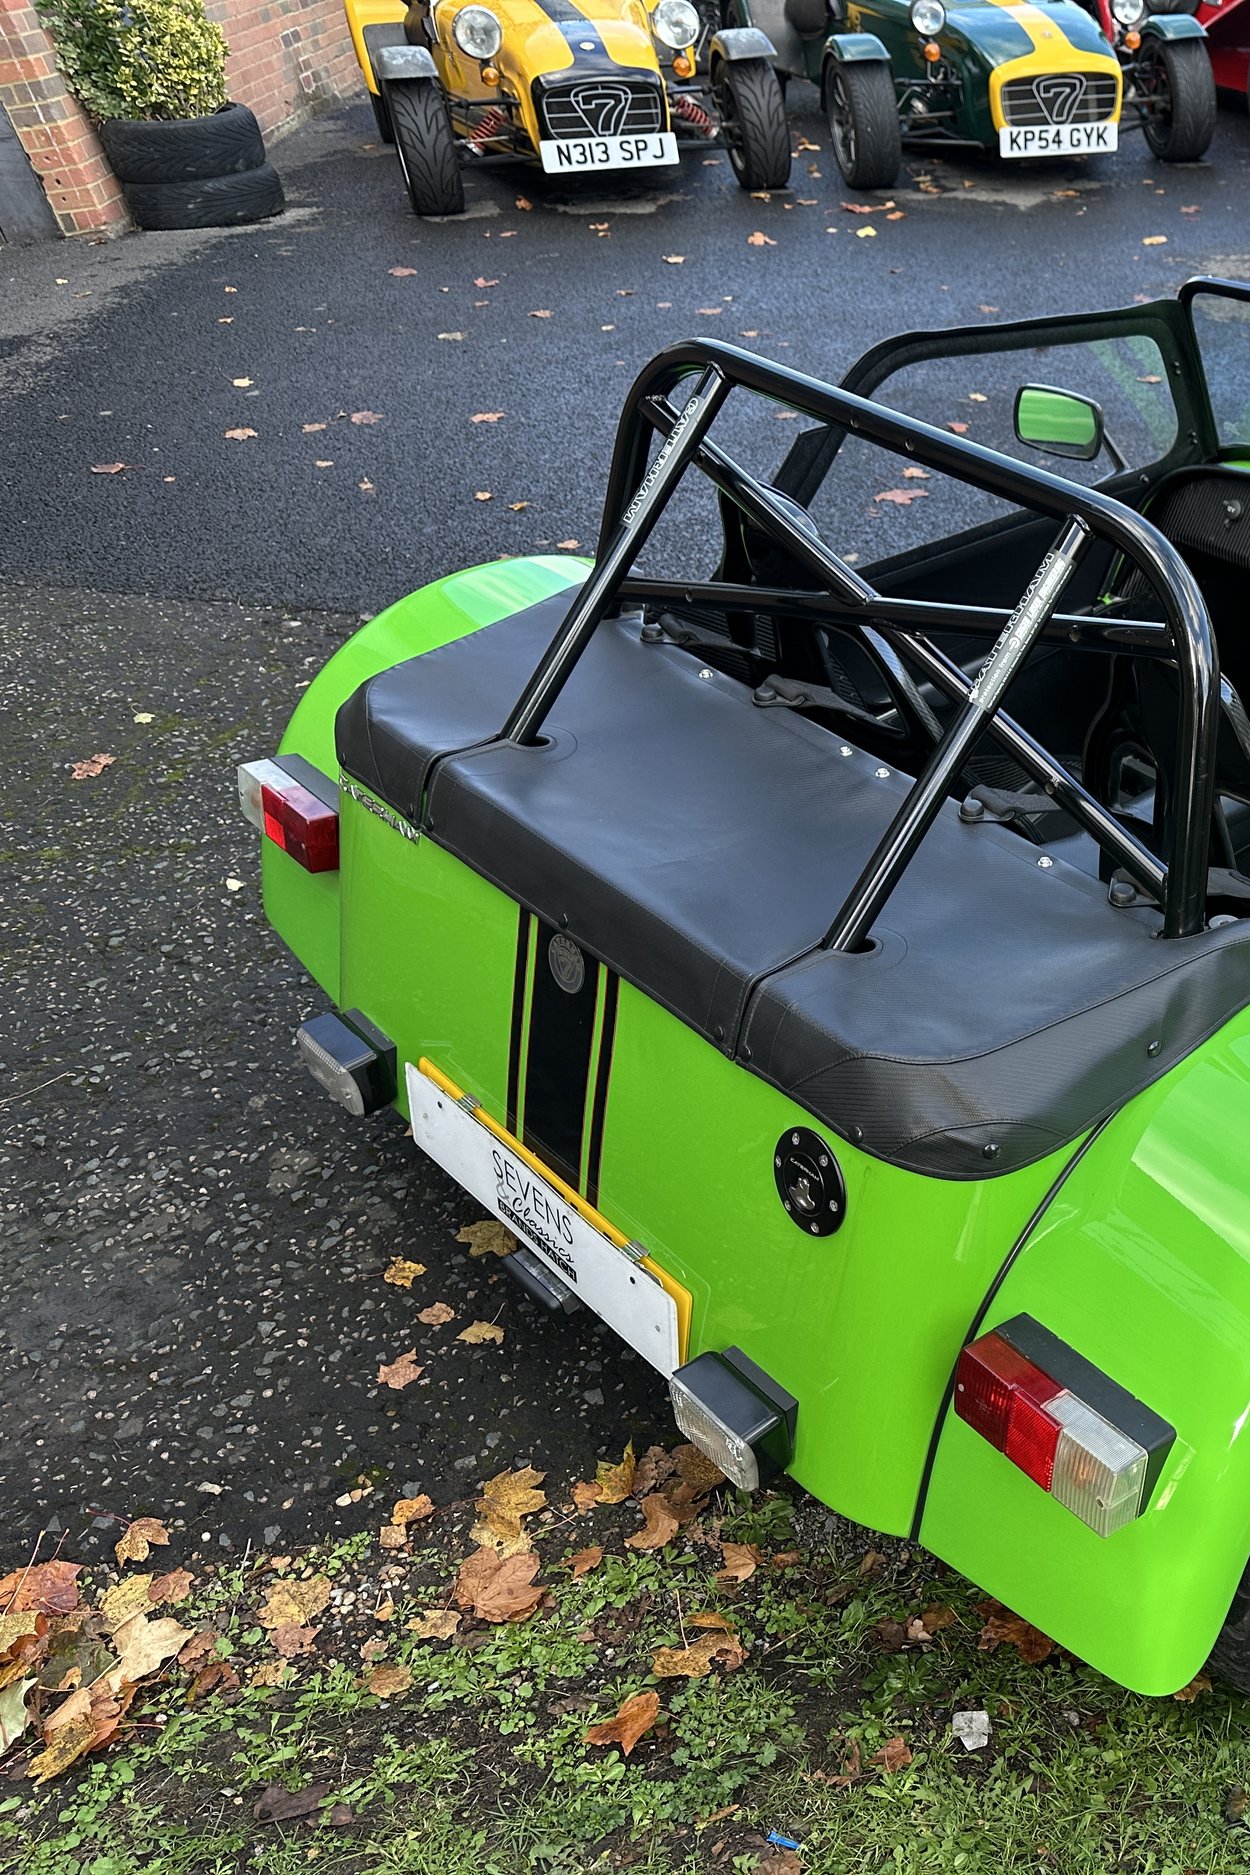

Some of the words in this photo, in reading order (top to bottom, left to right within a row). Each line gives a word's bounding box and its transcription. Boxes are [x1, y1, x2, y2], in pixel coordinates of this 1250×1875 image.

[556, 142, 610, 166] N313
[620, 138, 665, 161] SPJ
[1010, 129, 1062, 151] KP54
[1070, 126, 1107, 148] GYK
[623, 397, 699, 524] CATERHAM
[979, 668, 1001, 704] protection
[999, 651, 1012, 669] from
[492, 1149, 574, 1245] SEVENS
[512, 1197, 575, 1263] Classics
[499, 1202, 541, 1246] BRANDS
[541, 1244, 577, 1281] HATCH
